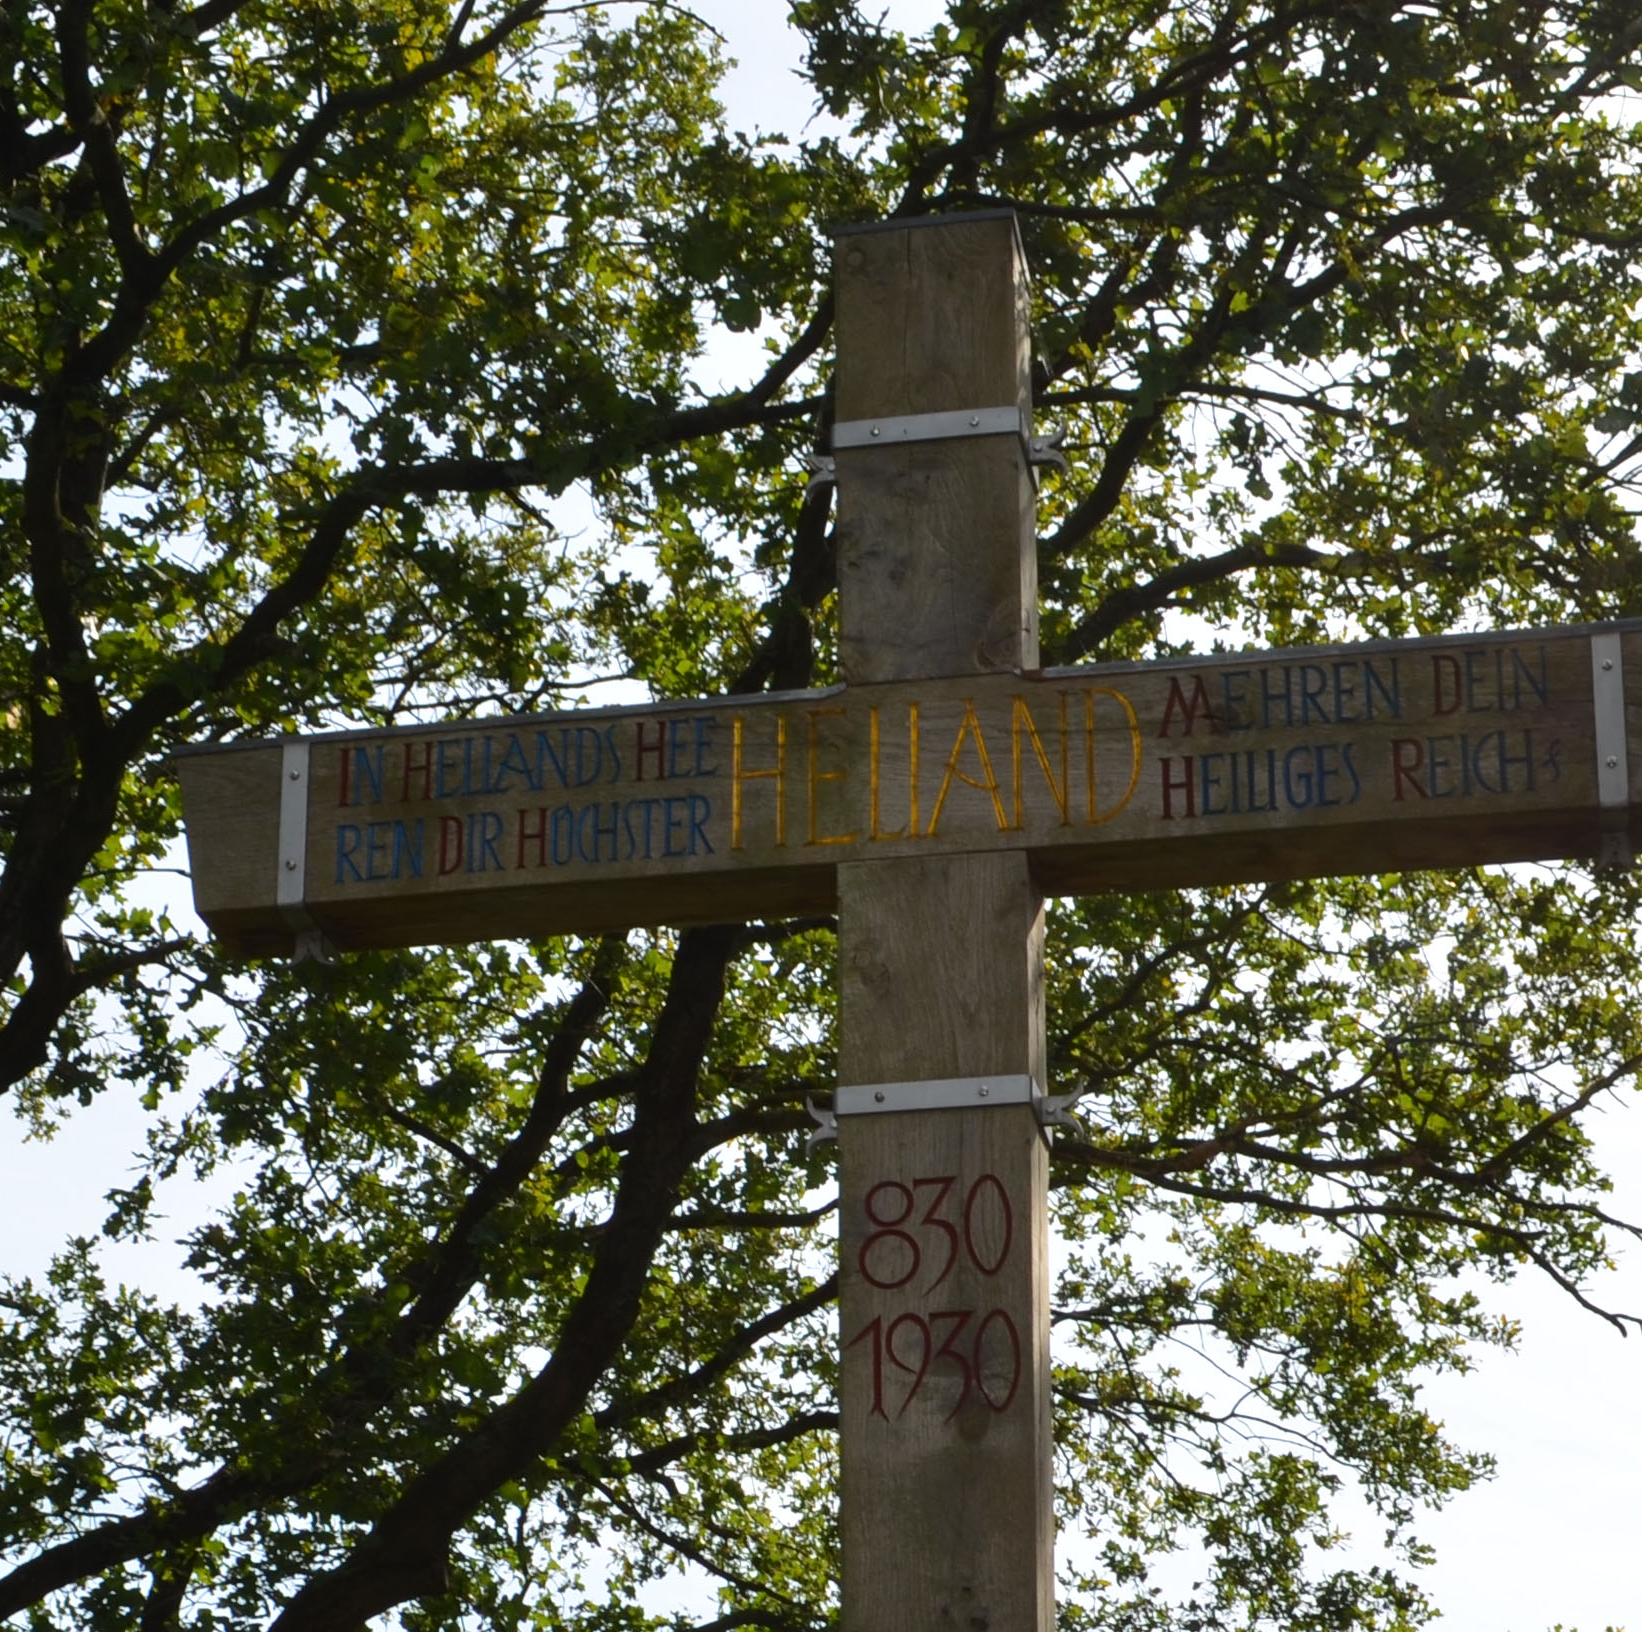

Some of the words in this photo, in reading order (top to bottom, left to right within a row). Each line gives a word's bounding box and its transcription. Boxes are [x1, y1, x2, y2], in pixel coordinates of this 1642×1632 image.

[1158, 658, 1402, 738] MEHREN
[1431, 645, 1550, 717] DEIN
[338, 744, 386, 808] IN
[633, 715, 718, 782] HEE
[1158, 742, 1361, 820] HEILIGES
[1391, 728, 1539, 802] REICH
[334, 817, 426, 885] REN
[437, 811, 506, 877] DIR
[858, 1173, 1013, 1297] 830
[845, 1308, 1021, 1426] 1930
